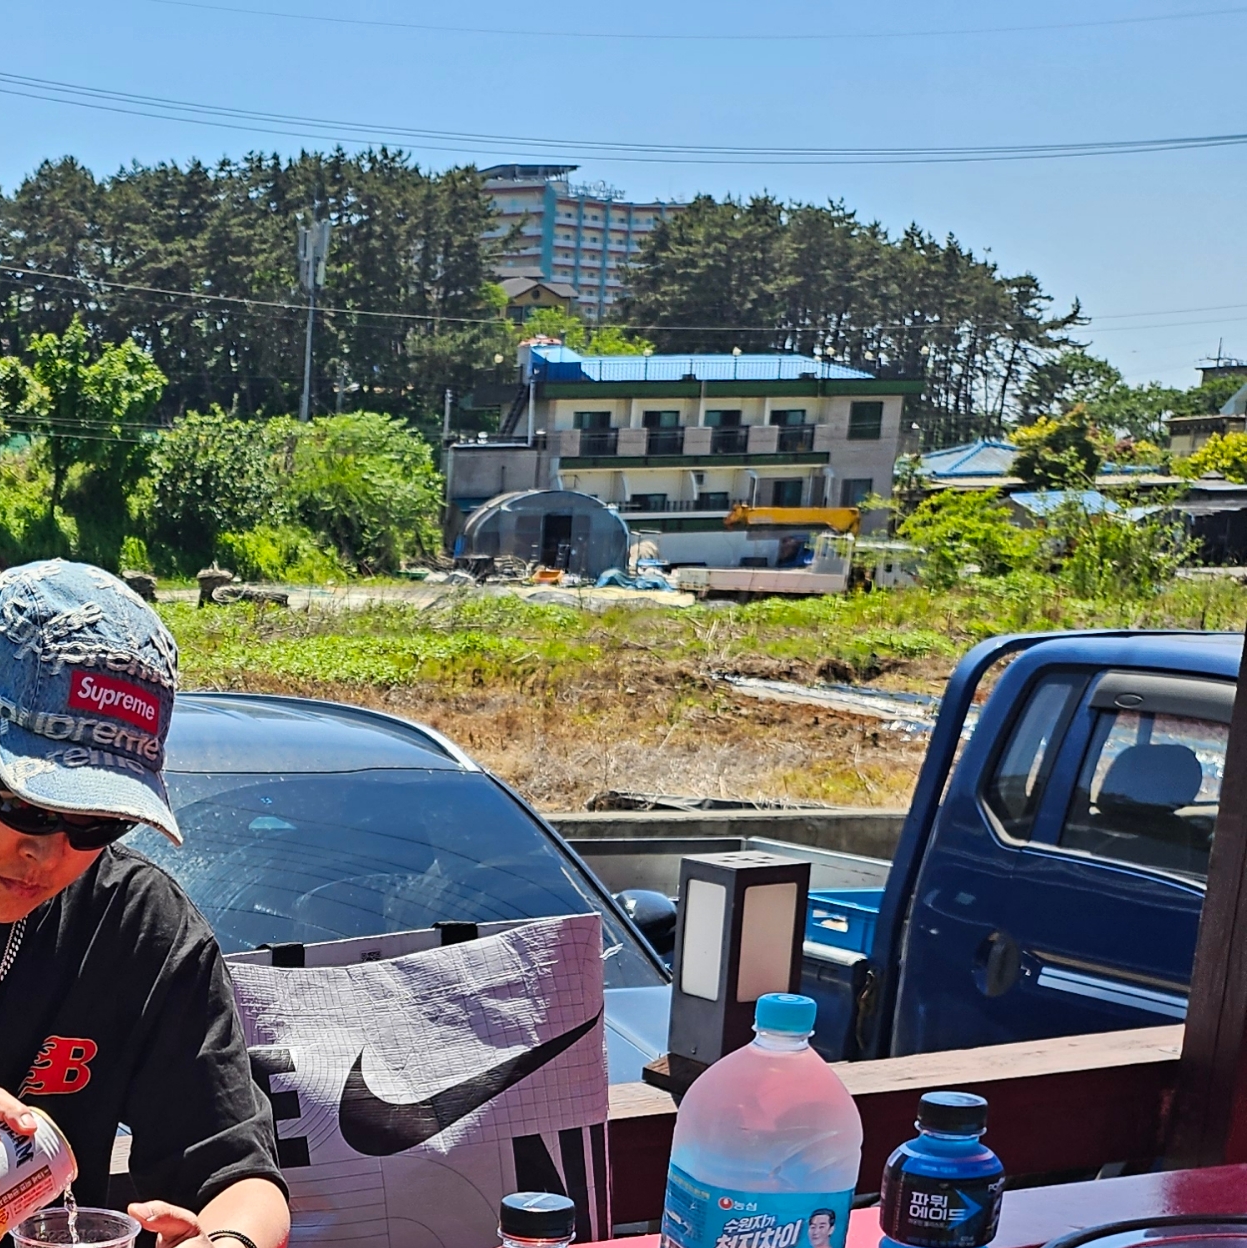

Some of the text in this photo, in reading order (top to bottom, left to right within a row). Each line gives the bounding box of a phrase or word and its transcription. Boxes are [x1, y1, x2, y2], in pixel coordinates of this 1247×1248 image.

[77, 675, 156, 722] Supreme
[733, 1200, 757, 1212] 농심
[910, 1191, 948, 1208] 파워
[909, 1205, 966, 1221] 에이드
[723, 1213, 776, 1233] 수원지가
